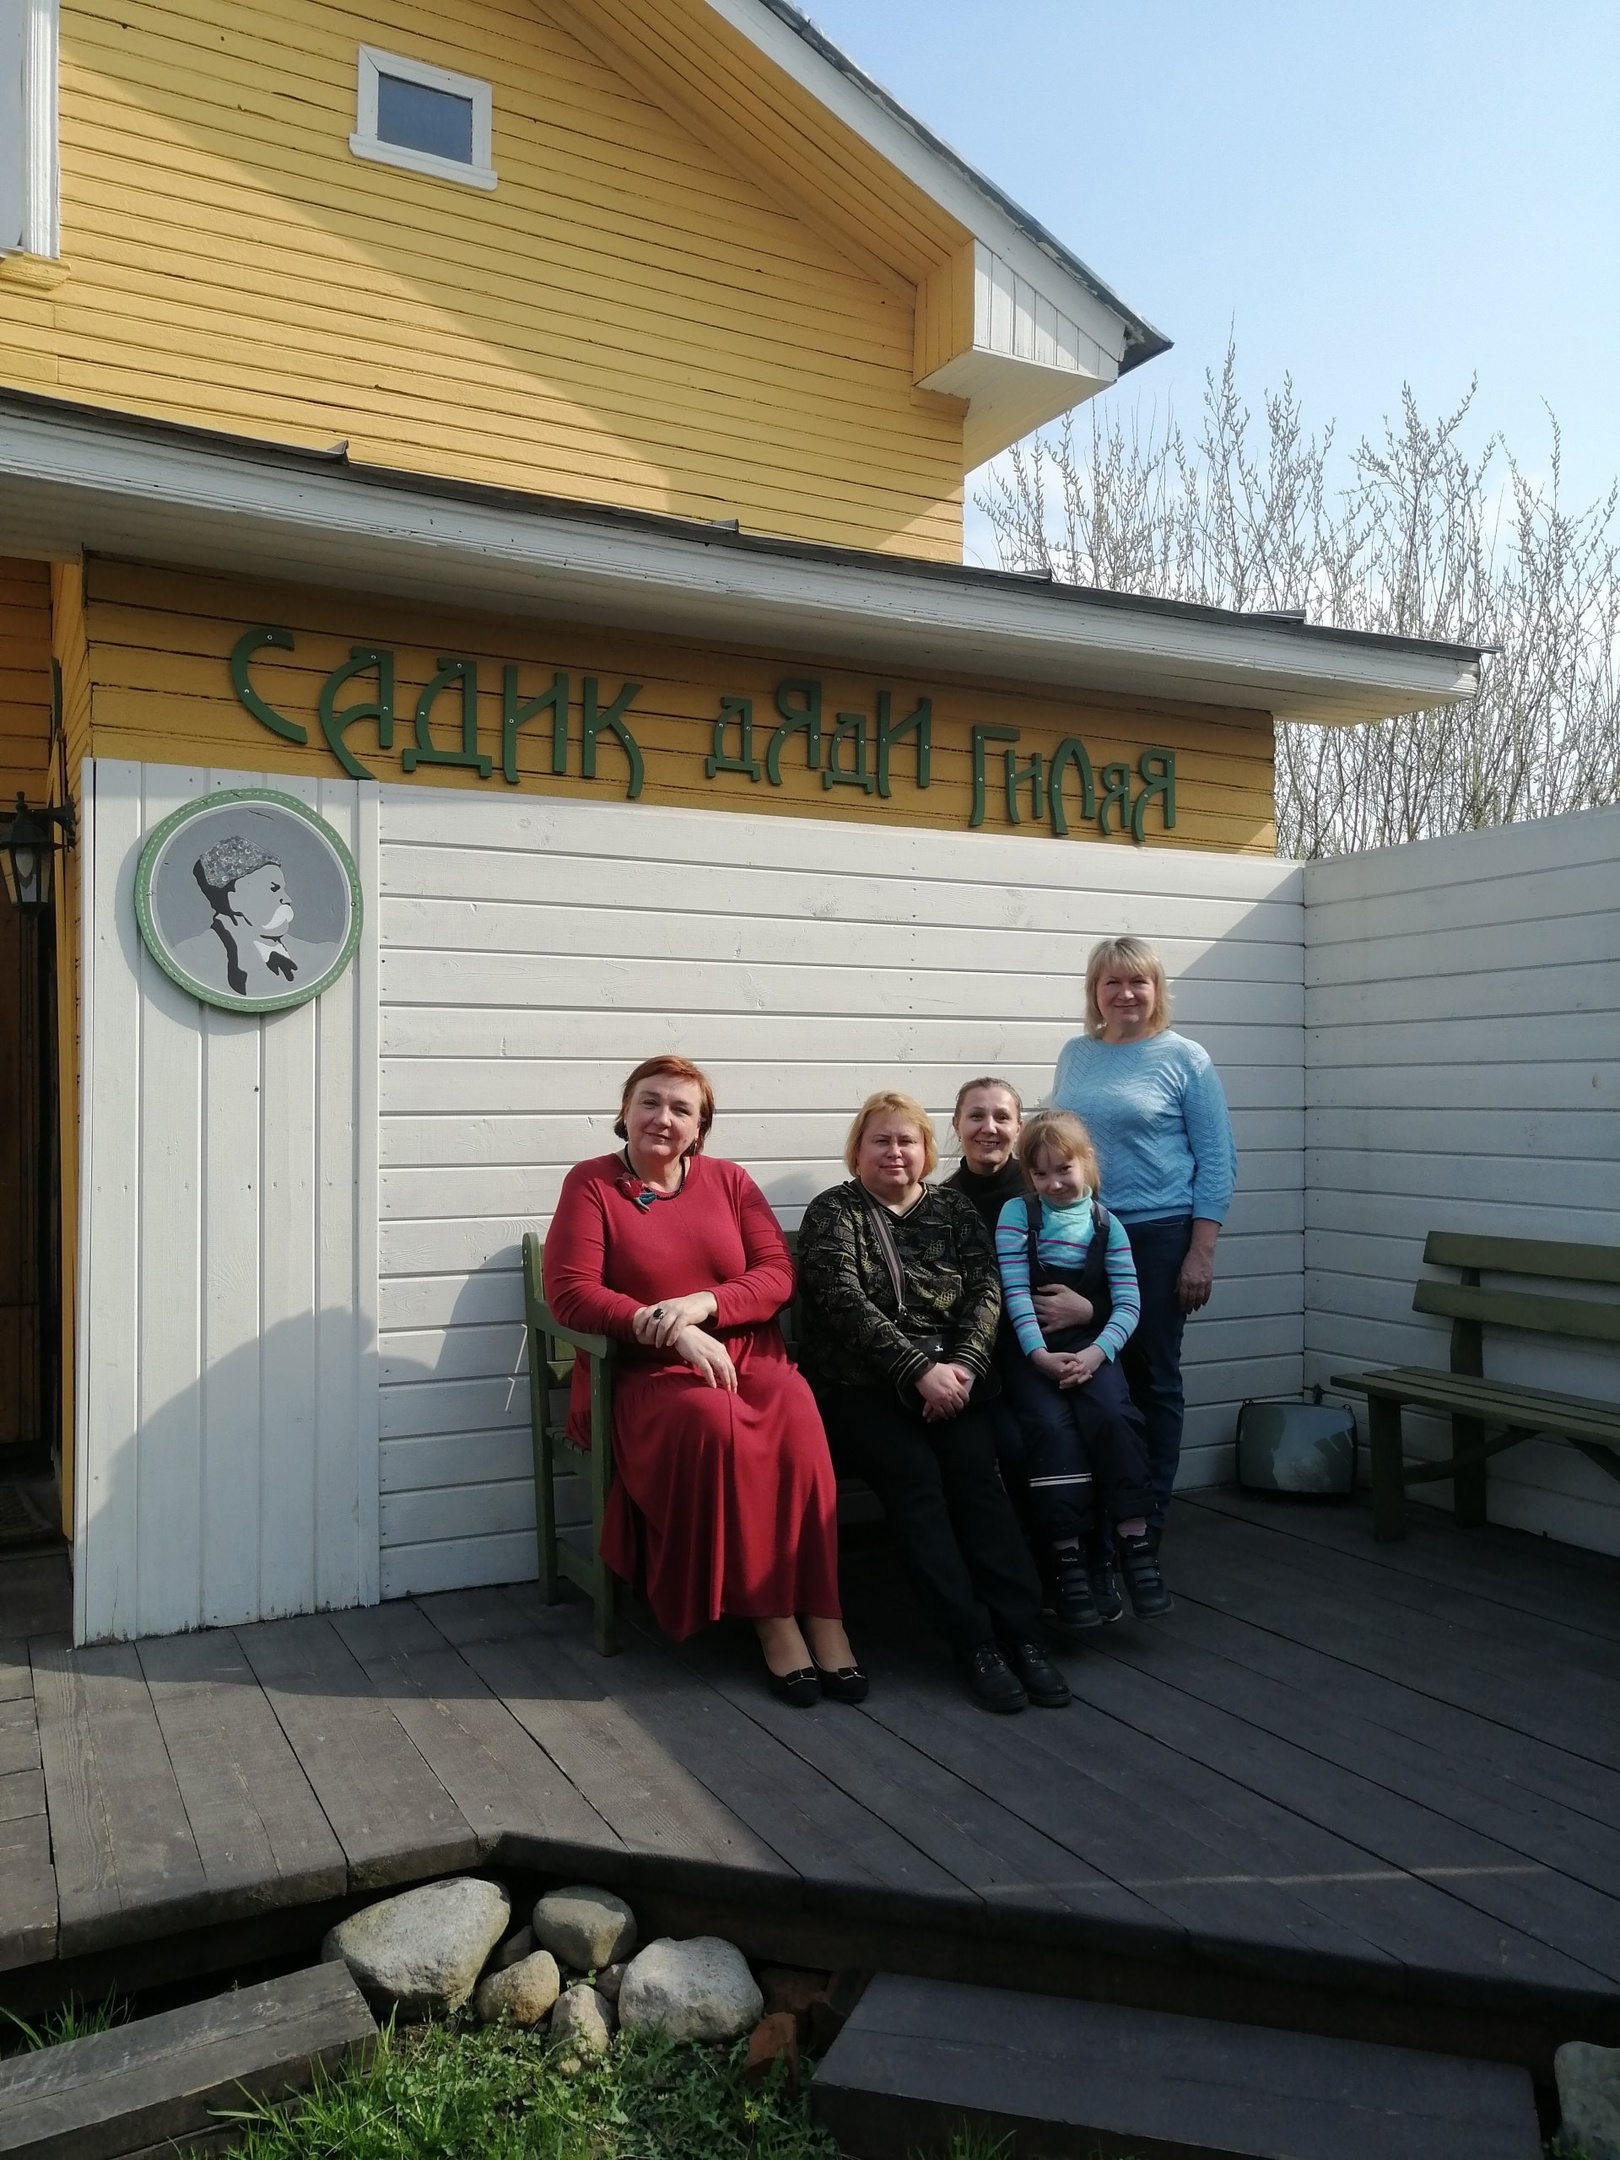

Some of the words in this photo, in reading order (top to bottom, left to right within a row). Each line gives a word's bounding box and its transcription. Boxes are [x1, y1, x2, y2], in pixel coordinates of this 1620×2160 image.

[231, 627, 645, 799] САДИК
[705, 678, 932, 798] ДЯДИ
[969, 724, 1176, 842] ГИЛЯЯ
